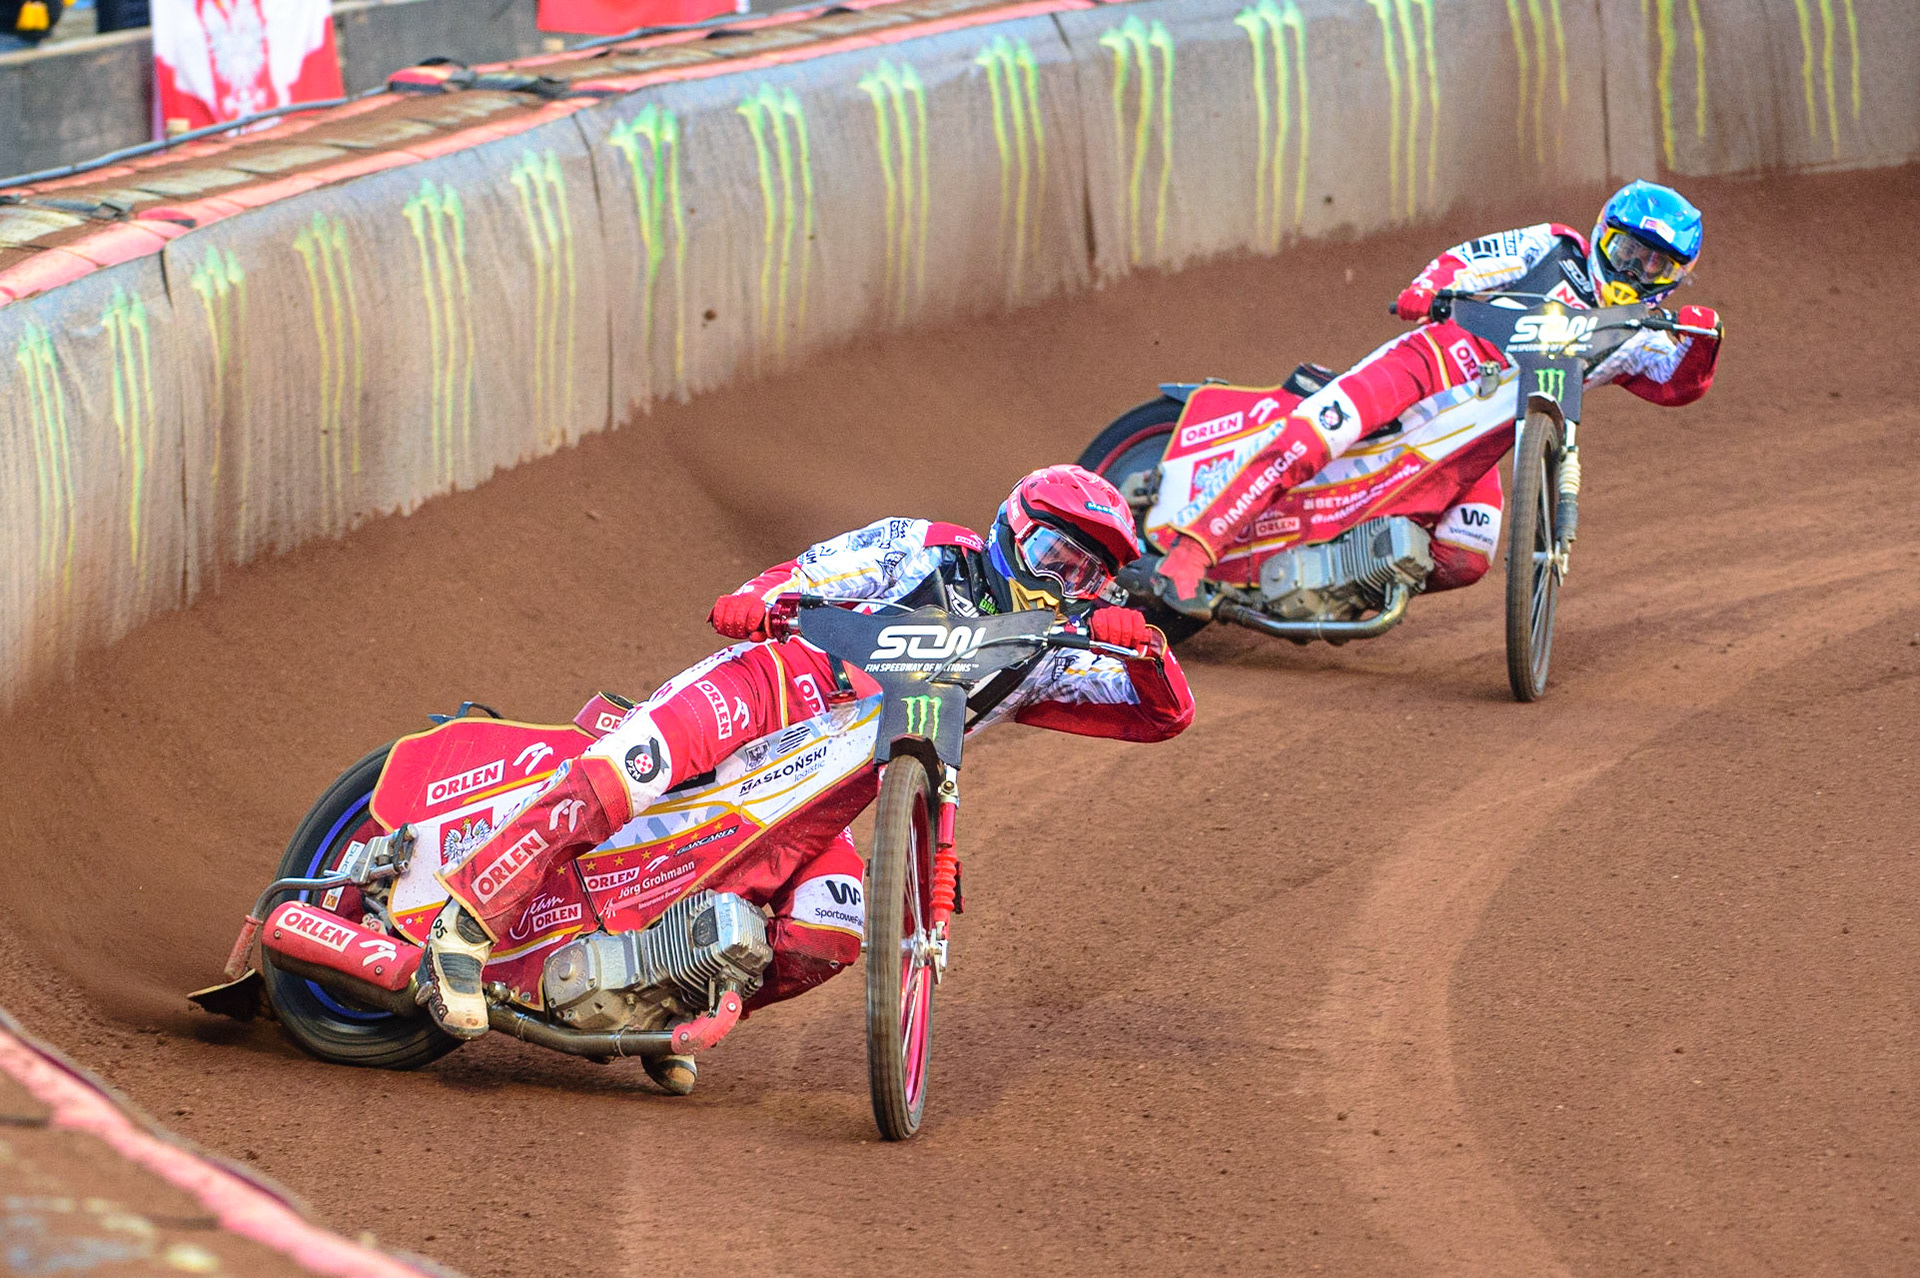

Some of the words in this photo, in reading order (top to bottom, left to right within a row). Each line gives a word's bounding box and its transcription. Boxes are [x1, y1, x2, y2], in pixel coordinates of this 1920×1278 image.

[1186, 416, 1239, 442] ORLEN
[1224, 440, 1308, 525] IMMERGAS
[1258, 520, 1296, 533] ORLEN
[864, 663, 880, 672] FIM
[879, 663, 923, 672] SPEEDWAY
[922, 663, 935, 672] OF
[701, 683, 730, 736] ORLEN
[431, 764, 499, 800] ORLEN
[626, 759, 641, 780] PZM
[739, 746, 827, 797] MASZOŃSKI
[478, 836, 542, 895] ORLEN
[587, 869, 637, 890] ORLEN
[618, 883, 641, 899] Jörg
[642, 861, 695, 889] Grohmann
[284, 912, 350, 947] ORLEN
[431, 918, 449, 940] 95
[509, 893, 565, 940] Team
[536, 906, 579, 929] ORLEN
